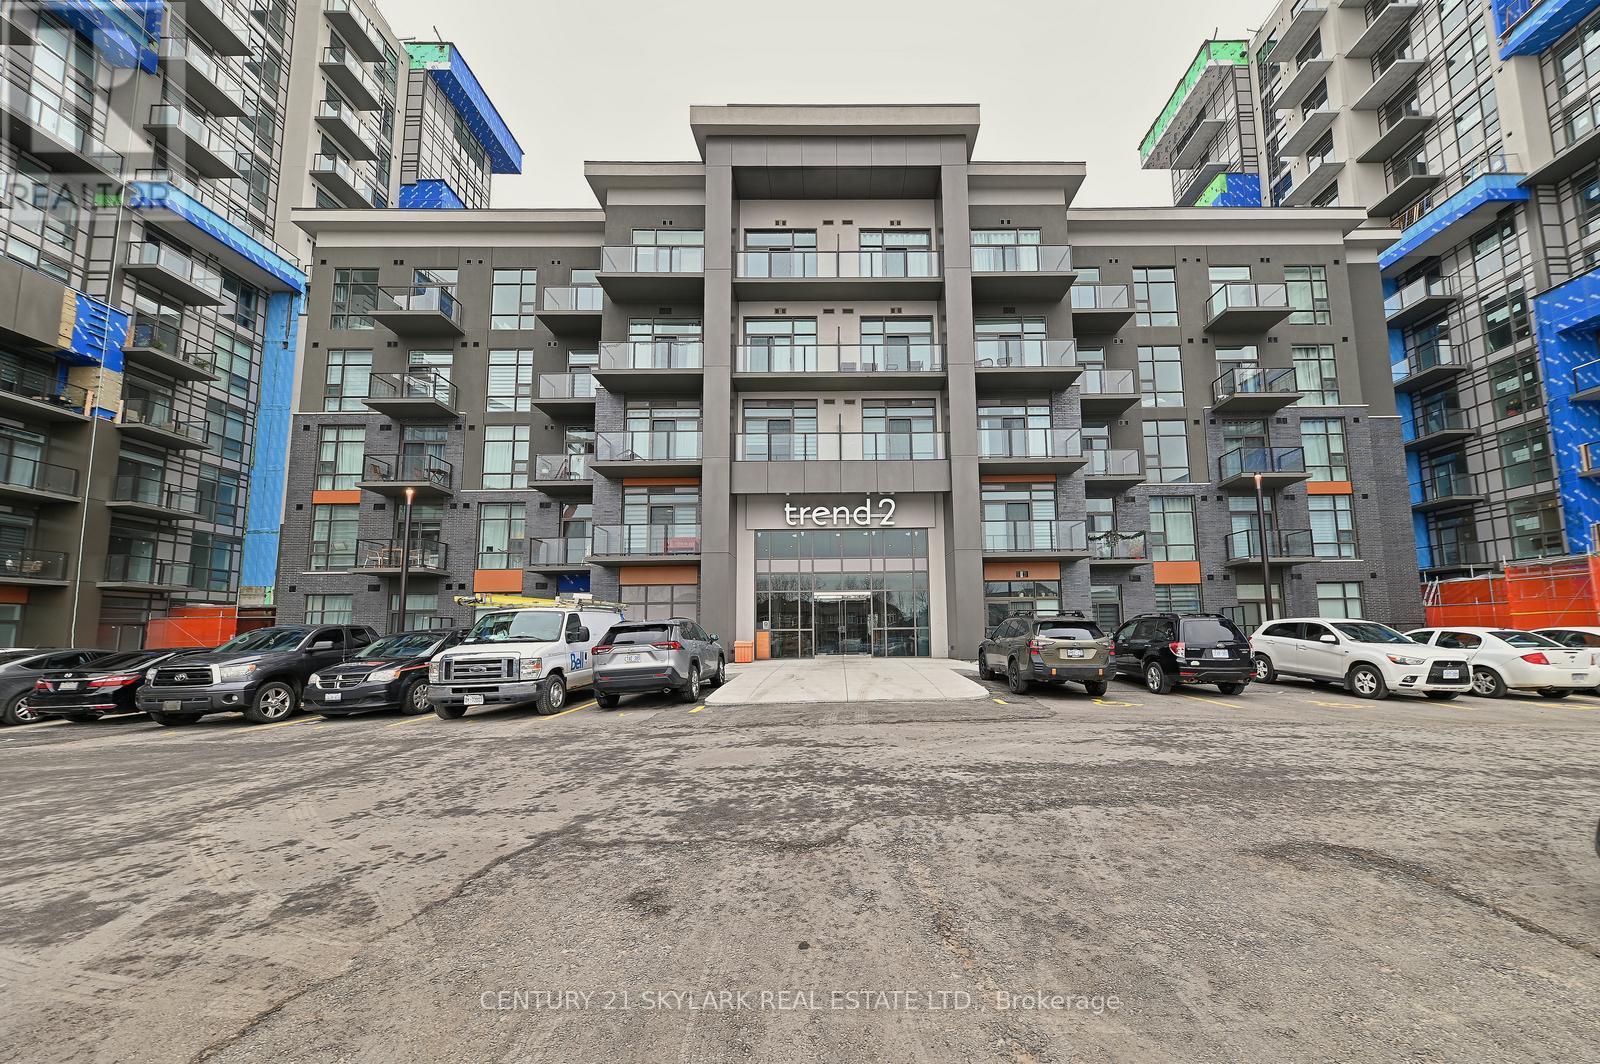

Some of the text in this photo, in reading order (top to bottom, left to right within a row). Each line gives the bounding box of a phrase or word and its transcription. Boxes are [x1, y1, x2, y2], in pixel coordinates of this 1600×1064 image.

[784, 498, 896, 526] trend 2
[570, 651, 584, 671] Bell
